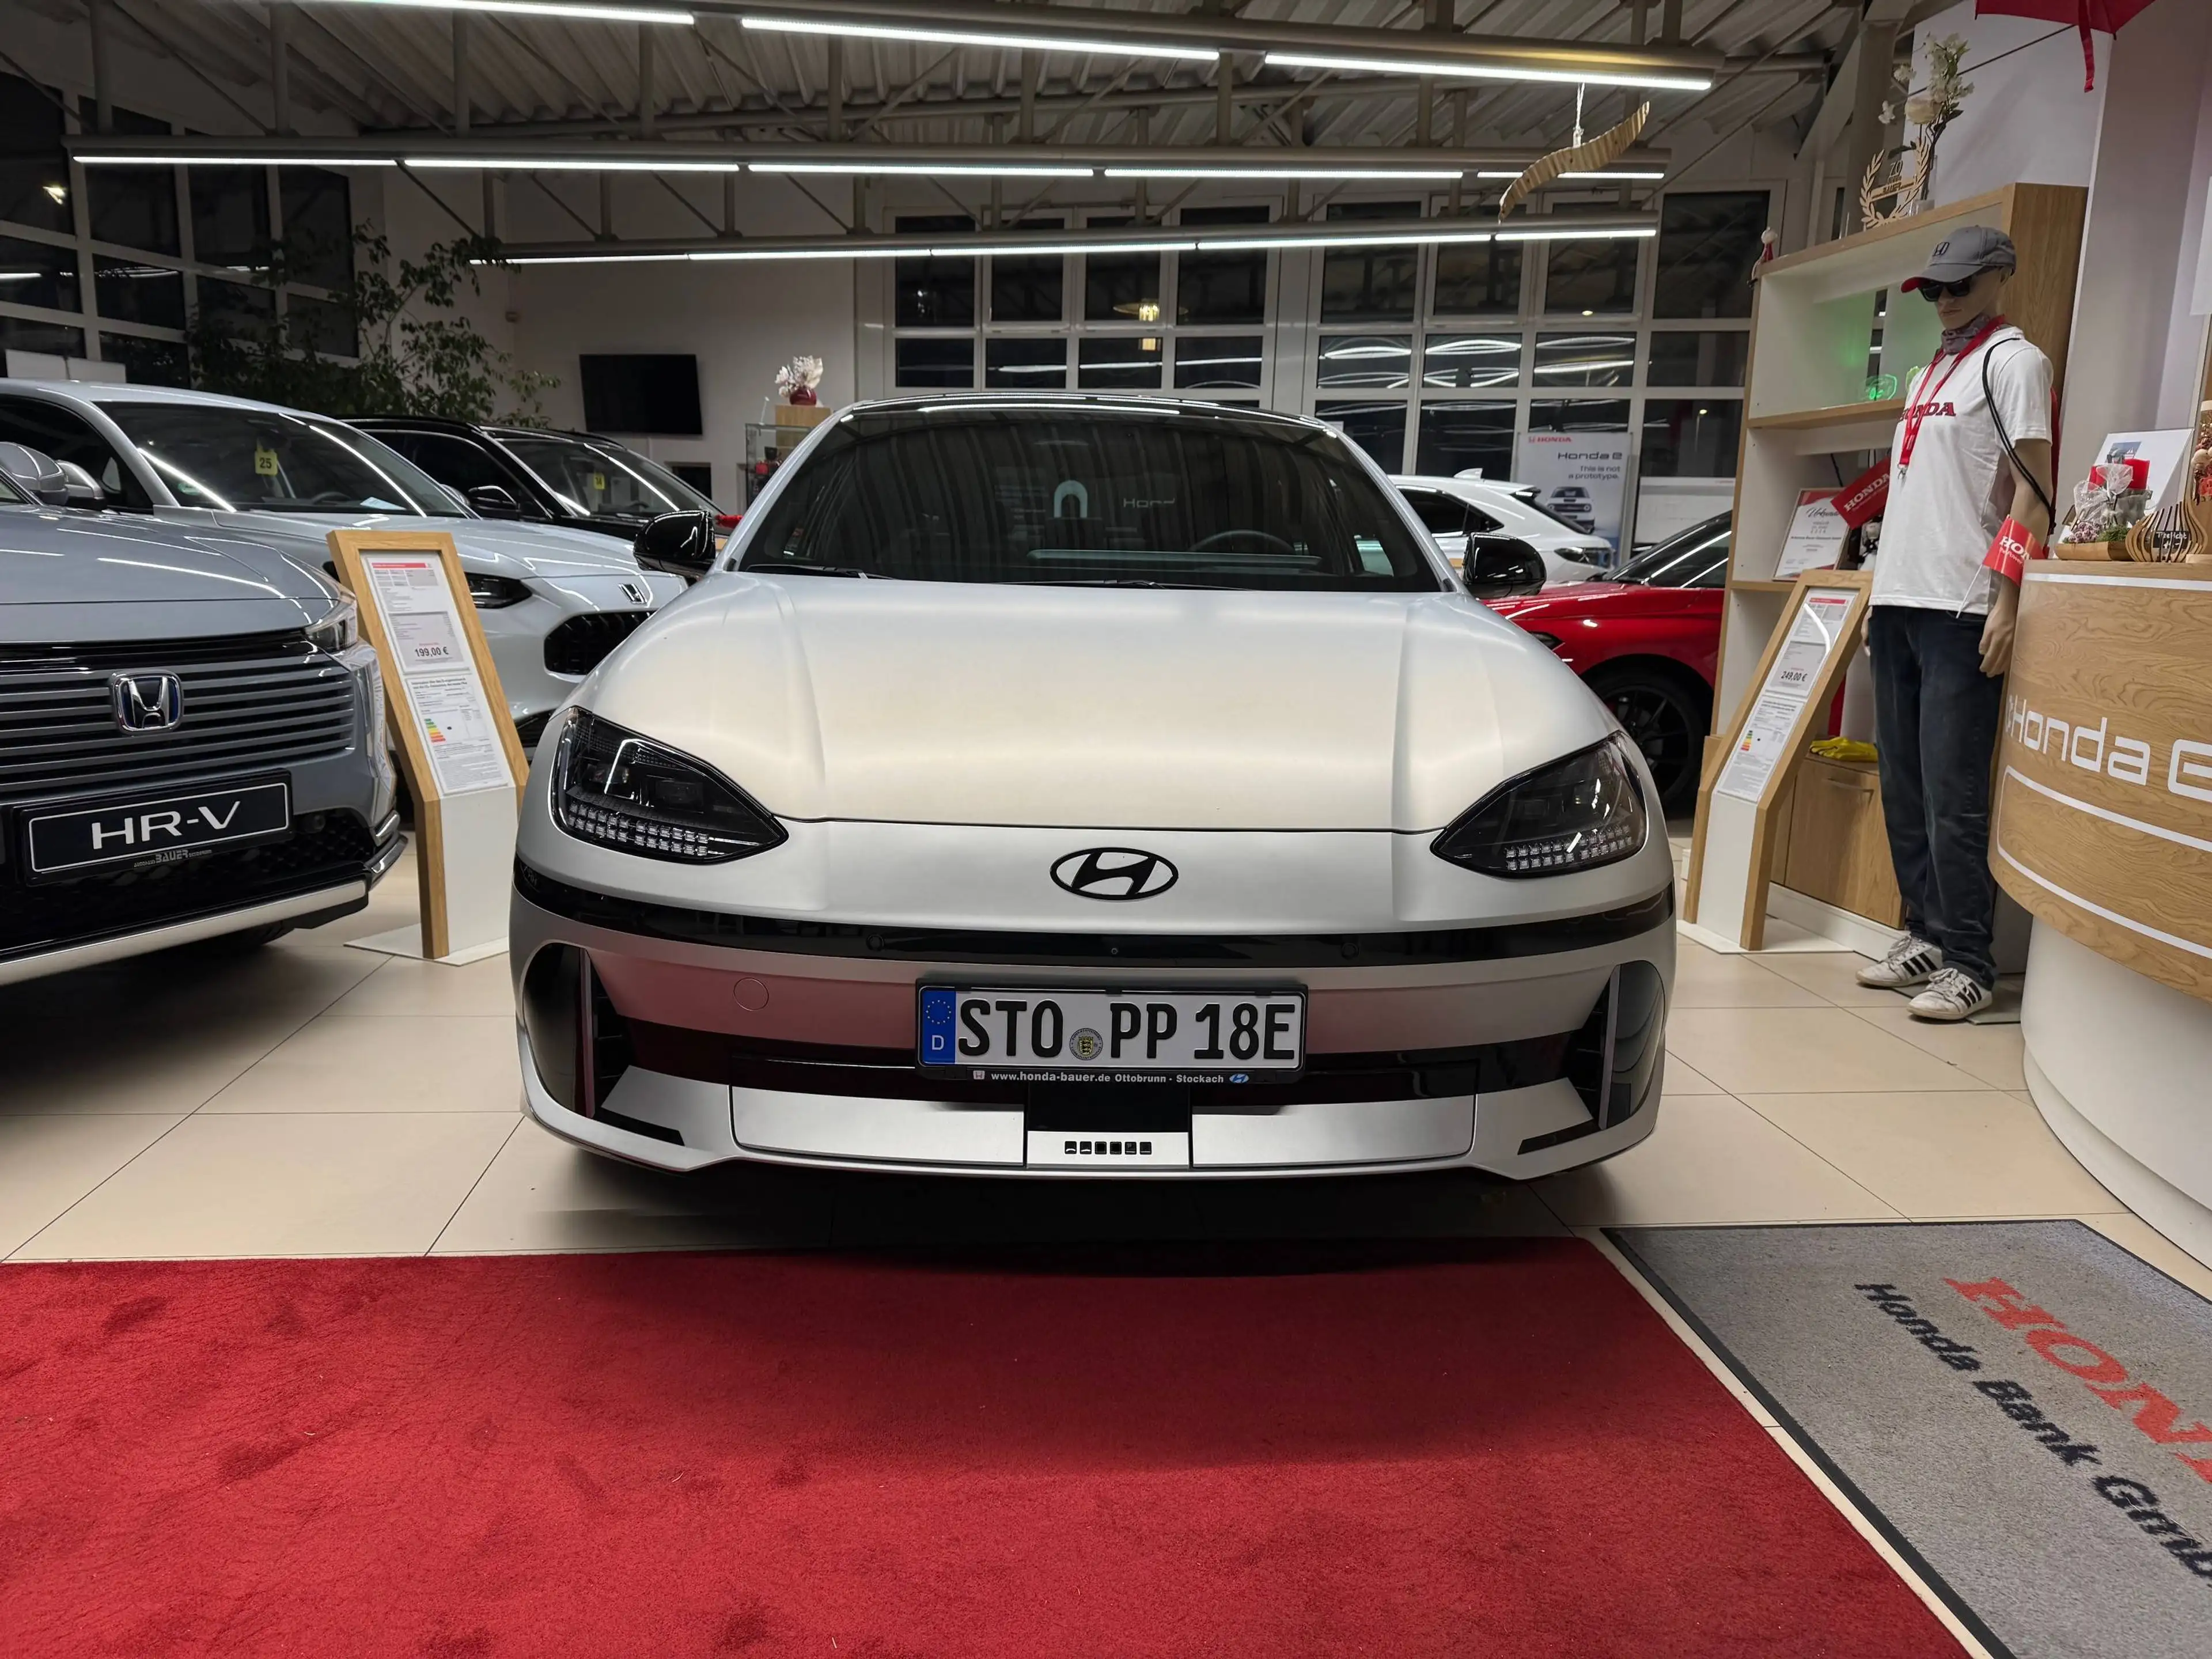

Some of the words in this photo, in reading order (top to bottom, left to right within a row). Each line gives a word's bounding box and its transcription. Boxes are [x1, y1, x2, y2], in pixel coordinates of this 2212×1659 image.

[259, 457, 272, 469] 25
[1558, 452, 1610, 460] Honda
[1843, 474, 1890, 512] HONDA
[415, 647, 441, 657] 199,00
[1781, 671, 1802, 681] 249,00
[2011, 695, 2150, 786] Honda
[92, 801, 240, 850] HR-V
[156, 849, 188, 864] BAUER
[959, 999, 1063, 1058] STO
[1109, 1002, 1177, 1059] PP
[1194, 1003, 1296, 1060] 18E
[931, 1035, 944, 1051] D
[991, 1071, 1111, 1082] www.honda-bauer.de
[1115, 1074, 1166, 1083] Ottobrunn
[1176, 1074, 1224, 1083] Stockach
[1854, 1283, 1983, 1372] Honda
[1972, 1380, 2103, 1466] Bank
[2092, 1475, 2212, 1586] Gmb
